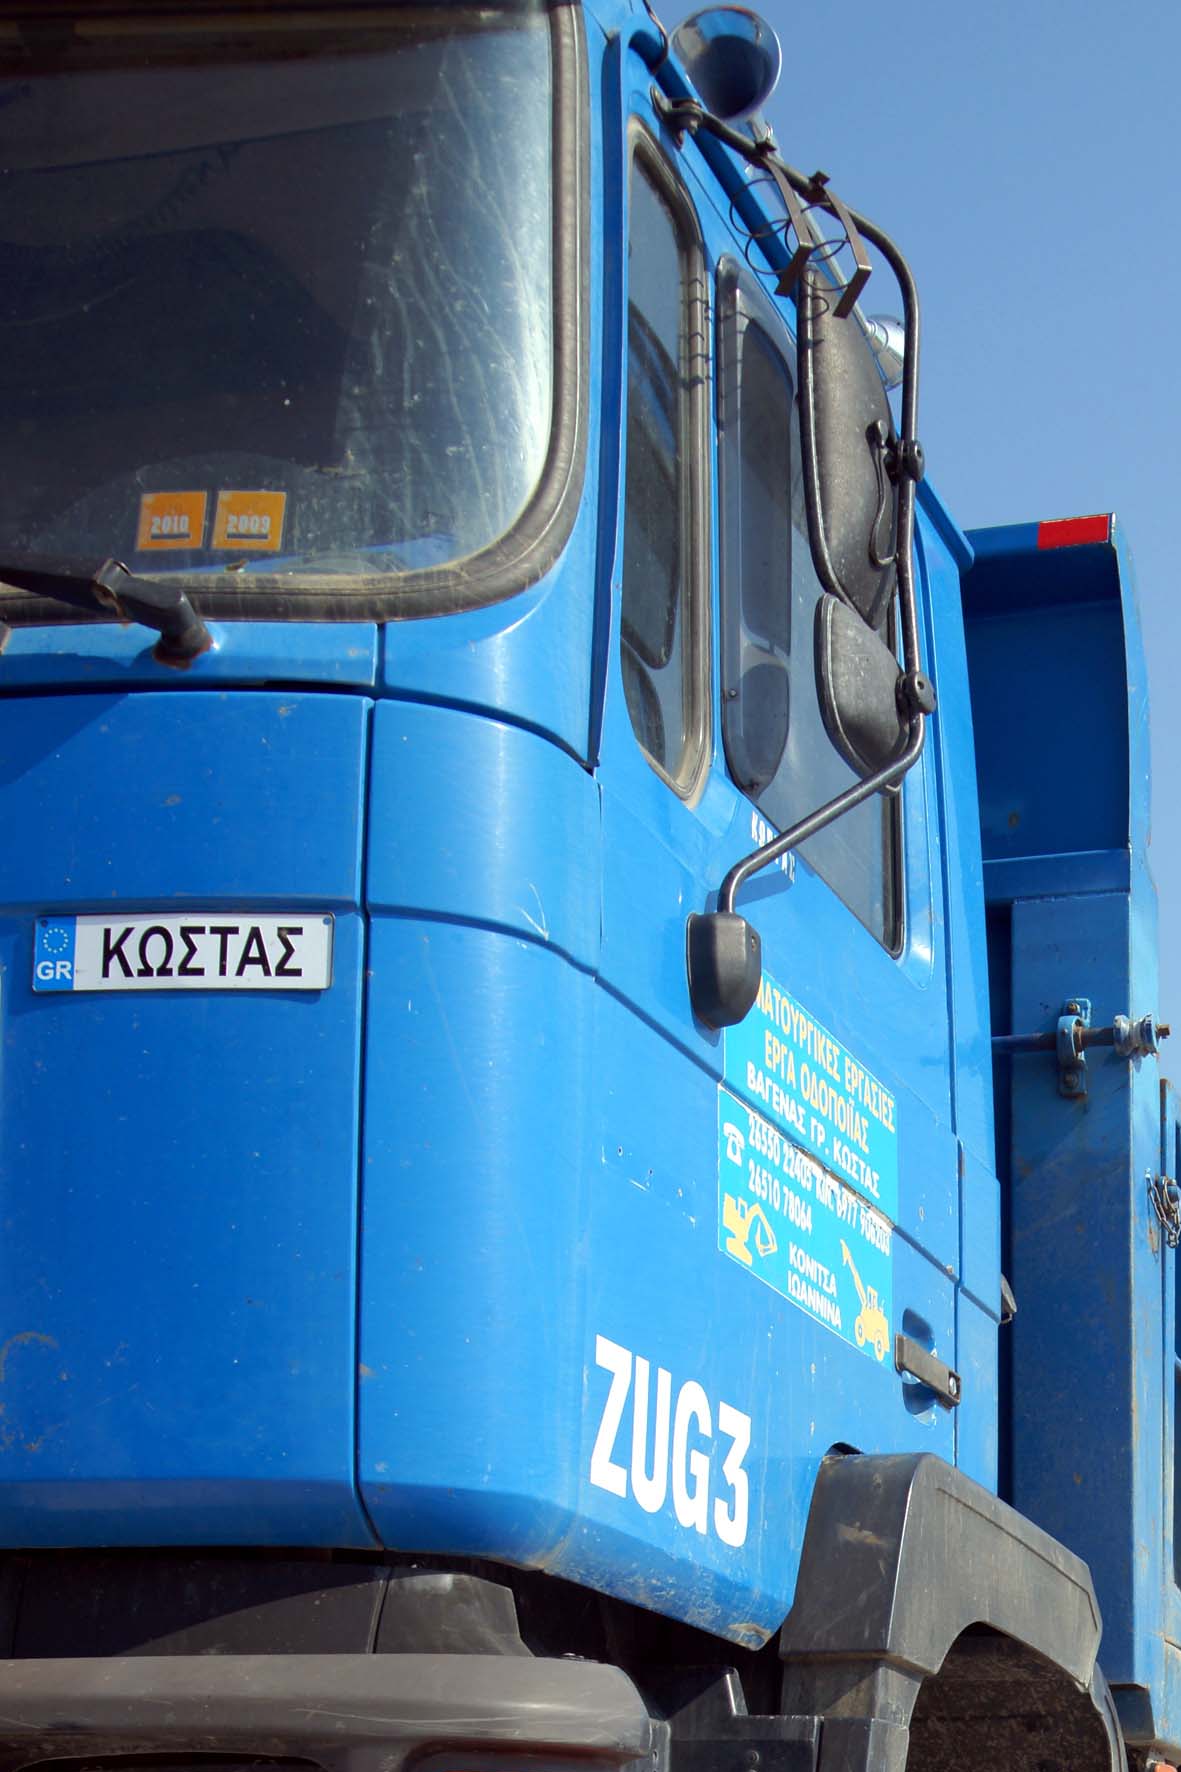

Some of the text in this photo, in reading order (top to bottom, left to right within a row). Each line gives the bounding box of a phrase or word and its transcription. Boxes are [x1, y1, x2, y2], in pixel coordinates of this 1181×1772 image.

[151, 514, 190, 534] 2010
[36, 961, 72, 980] GR
[101, 925, 304, 978] ΚΩΣΤΑΣ
[756, 975, 896, 1134] ΜΑΤΟΥΡΓΙΚΕΣ ΕΡΓΑΣΙΕΣ
[764, 1029, 797, 1090] ΕΡΓΑ
[746, 1060, 807, 1136] ΒΑΓΕΝΑΣ
[833, 1136, 881, 1200] ΚΩΣΤΑΣ
[748, 1112, 781, 1167] 26550
[748, 1158, 813, 1236] 26510 78064
[787, 1269, 842, 1330] ΙΩΑΝΝΙΝΑ
[788, 1241, 838, 1299] ΚΟΝΙΤΣΑ
[590, 1333, 752, 1548] ZUG3
